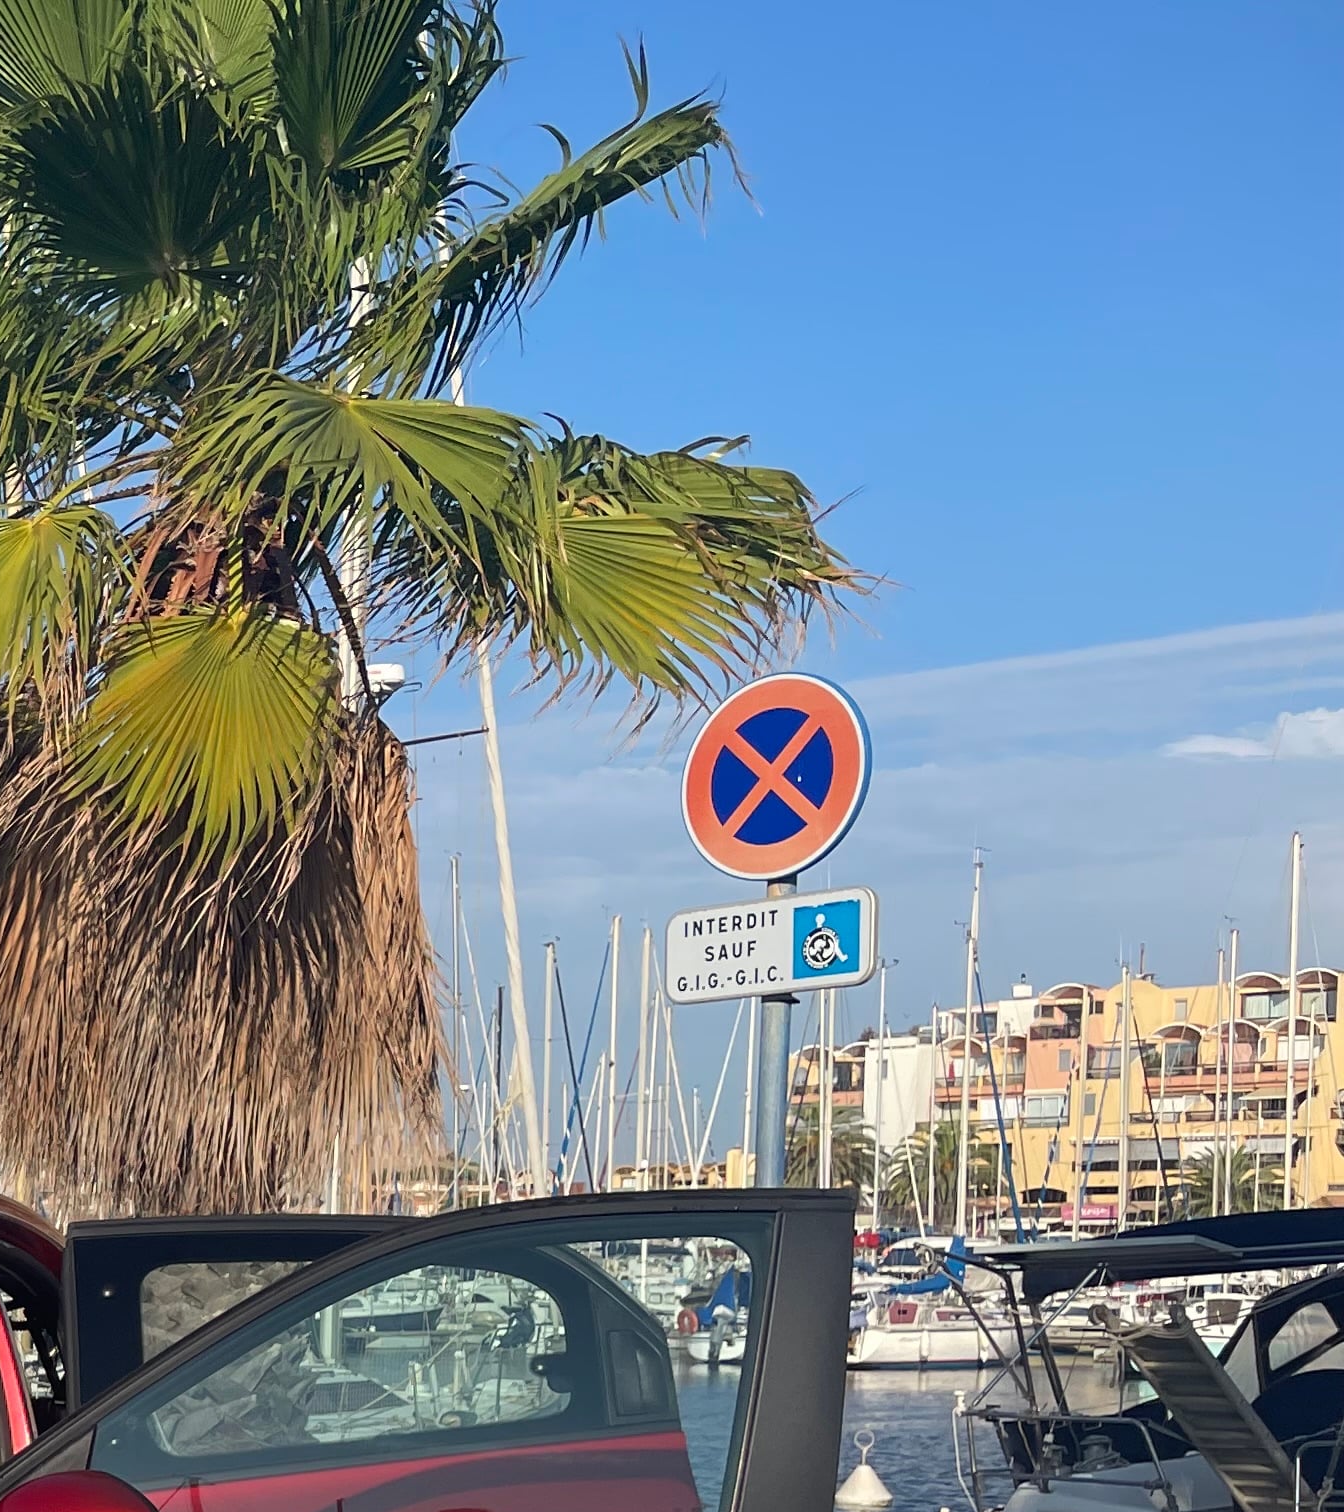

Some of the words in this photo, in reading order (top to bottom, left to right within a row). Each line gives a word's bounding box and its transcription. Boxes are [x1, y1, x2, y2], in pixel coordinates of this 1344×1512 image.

[684, 909, 778, 938] INTERDIT
[704, 940, 757, 962] SAUF
[677, 965, 784, 992] G.I.G.-G.I.C.
